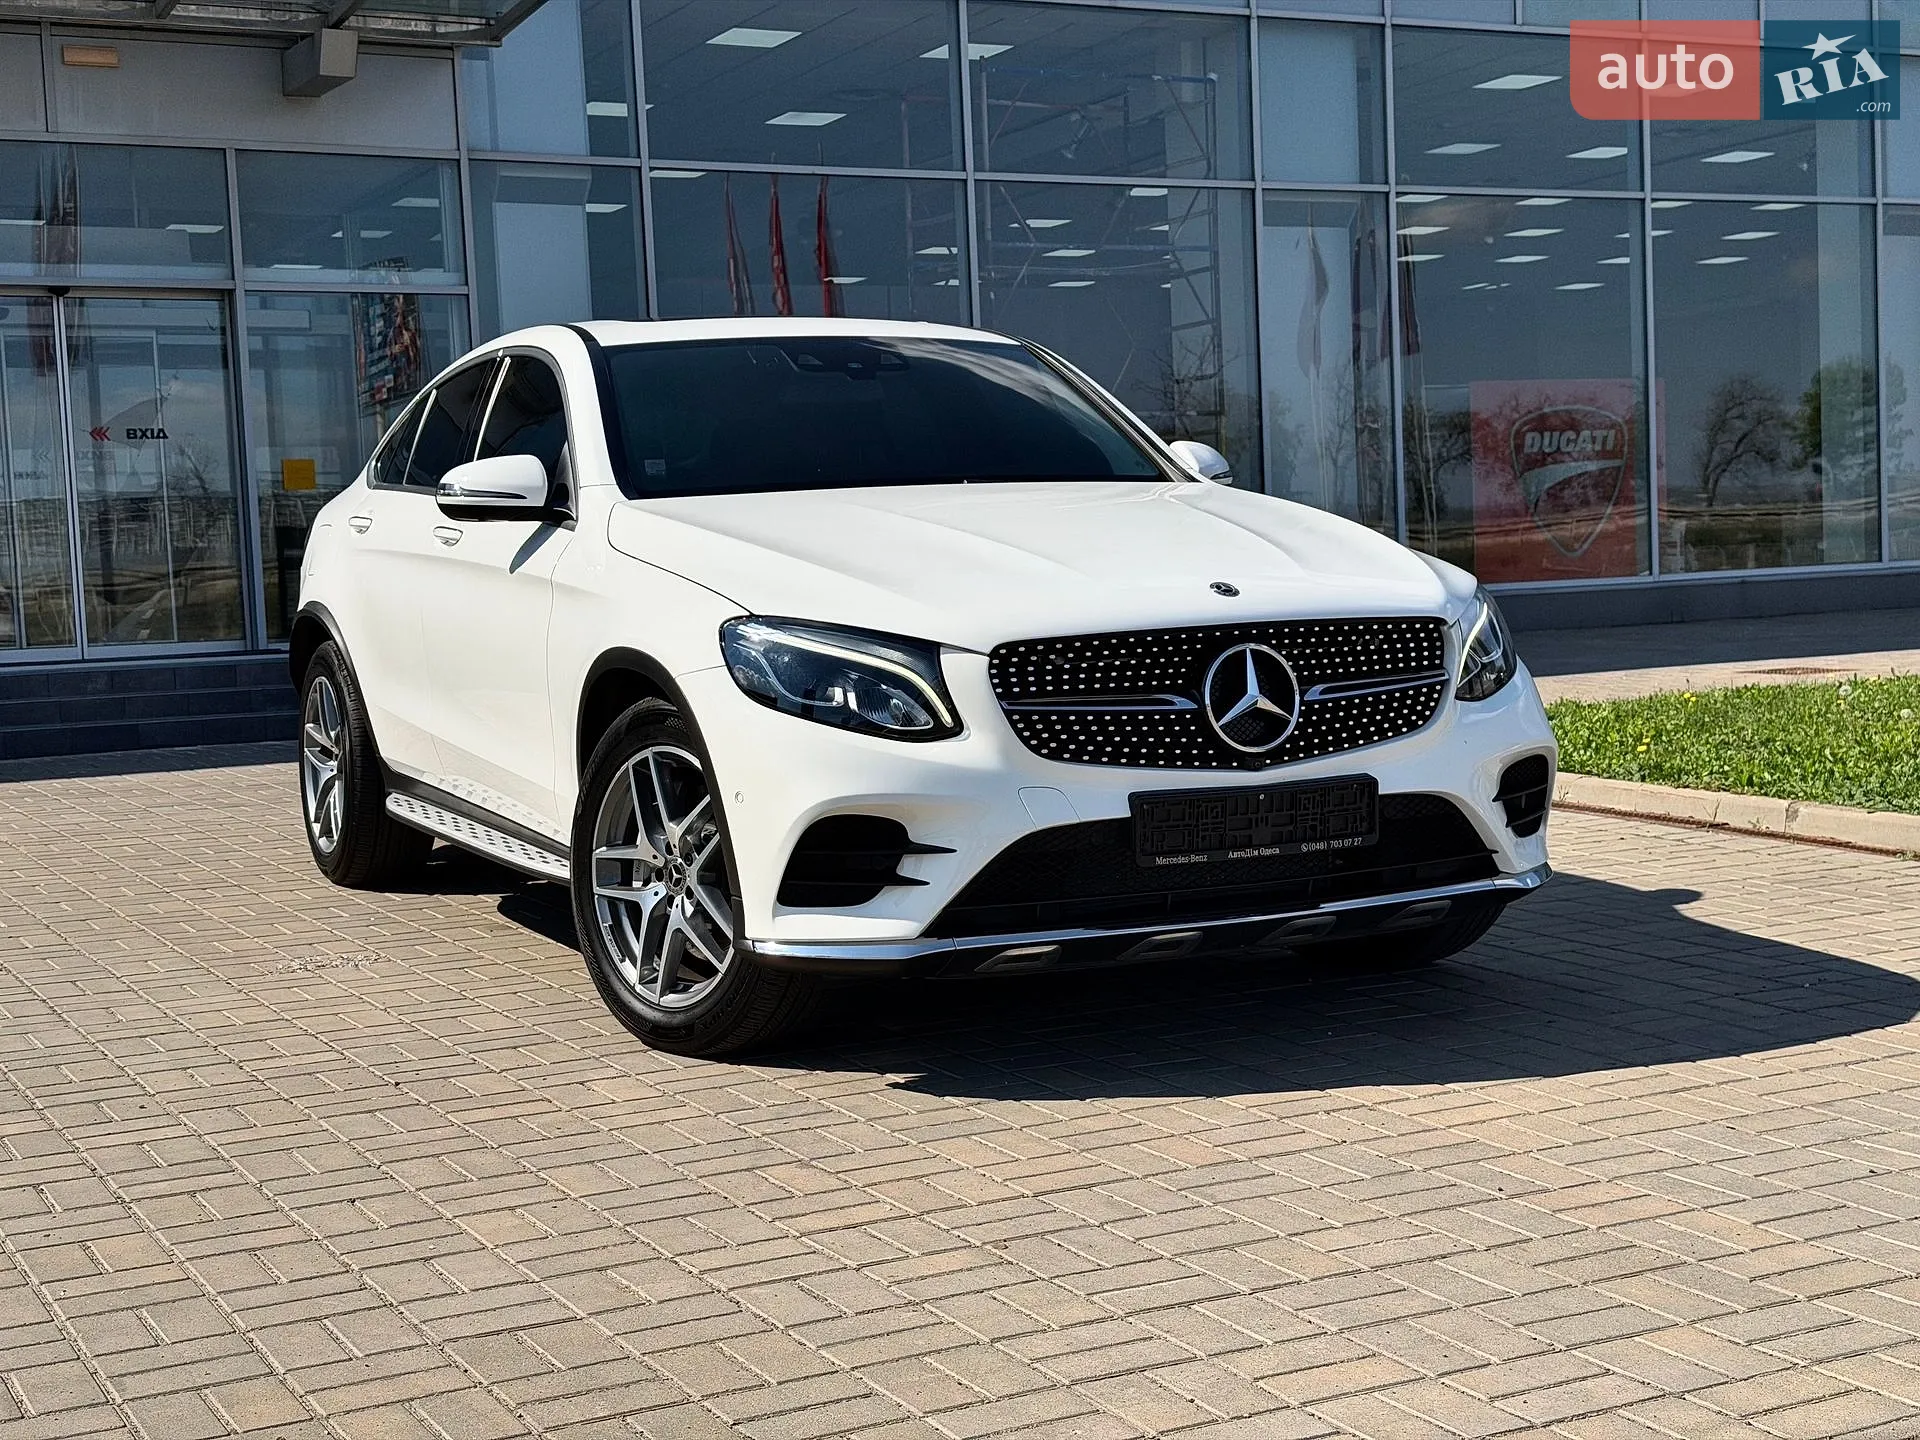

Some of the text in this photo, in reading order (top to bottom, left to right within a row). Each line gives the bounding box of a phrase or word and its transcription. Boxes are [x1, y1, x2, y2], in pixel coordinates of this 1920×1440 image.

[1524, 429, 1617, 454] DUCATI
[1329, 839, 1343, 849] 703
[1343, 838, 1353, 847] 07
[1353, 837, 1363, 846] 27
[1155, 854, 1208, 865] Mercedes-Benz
